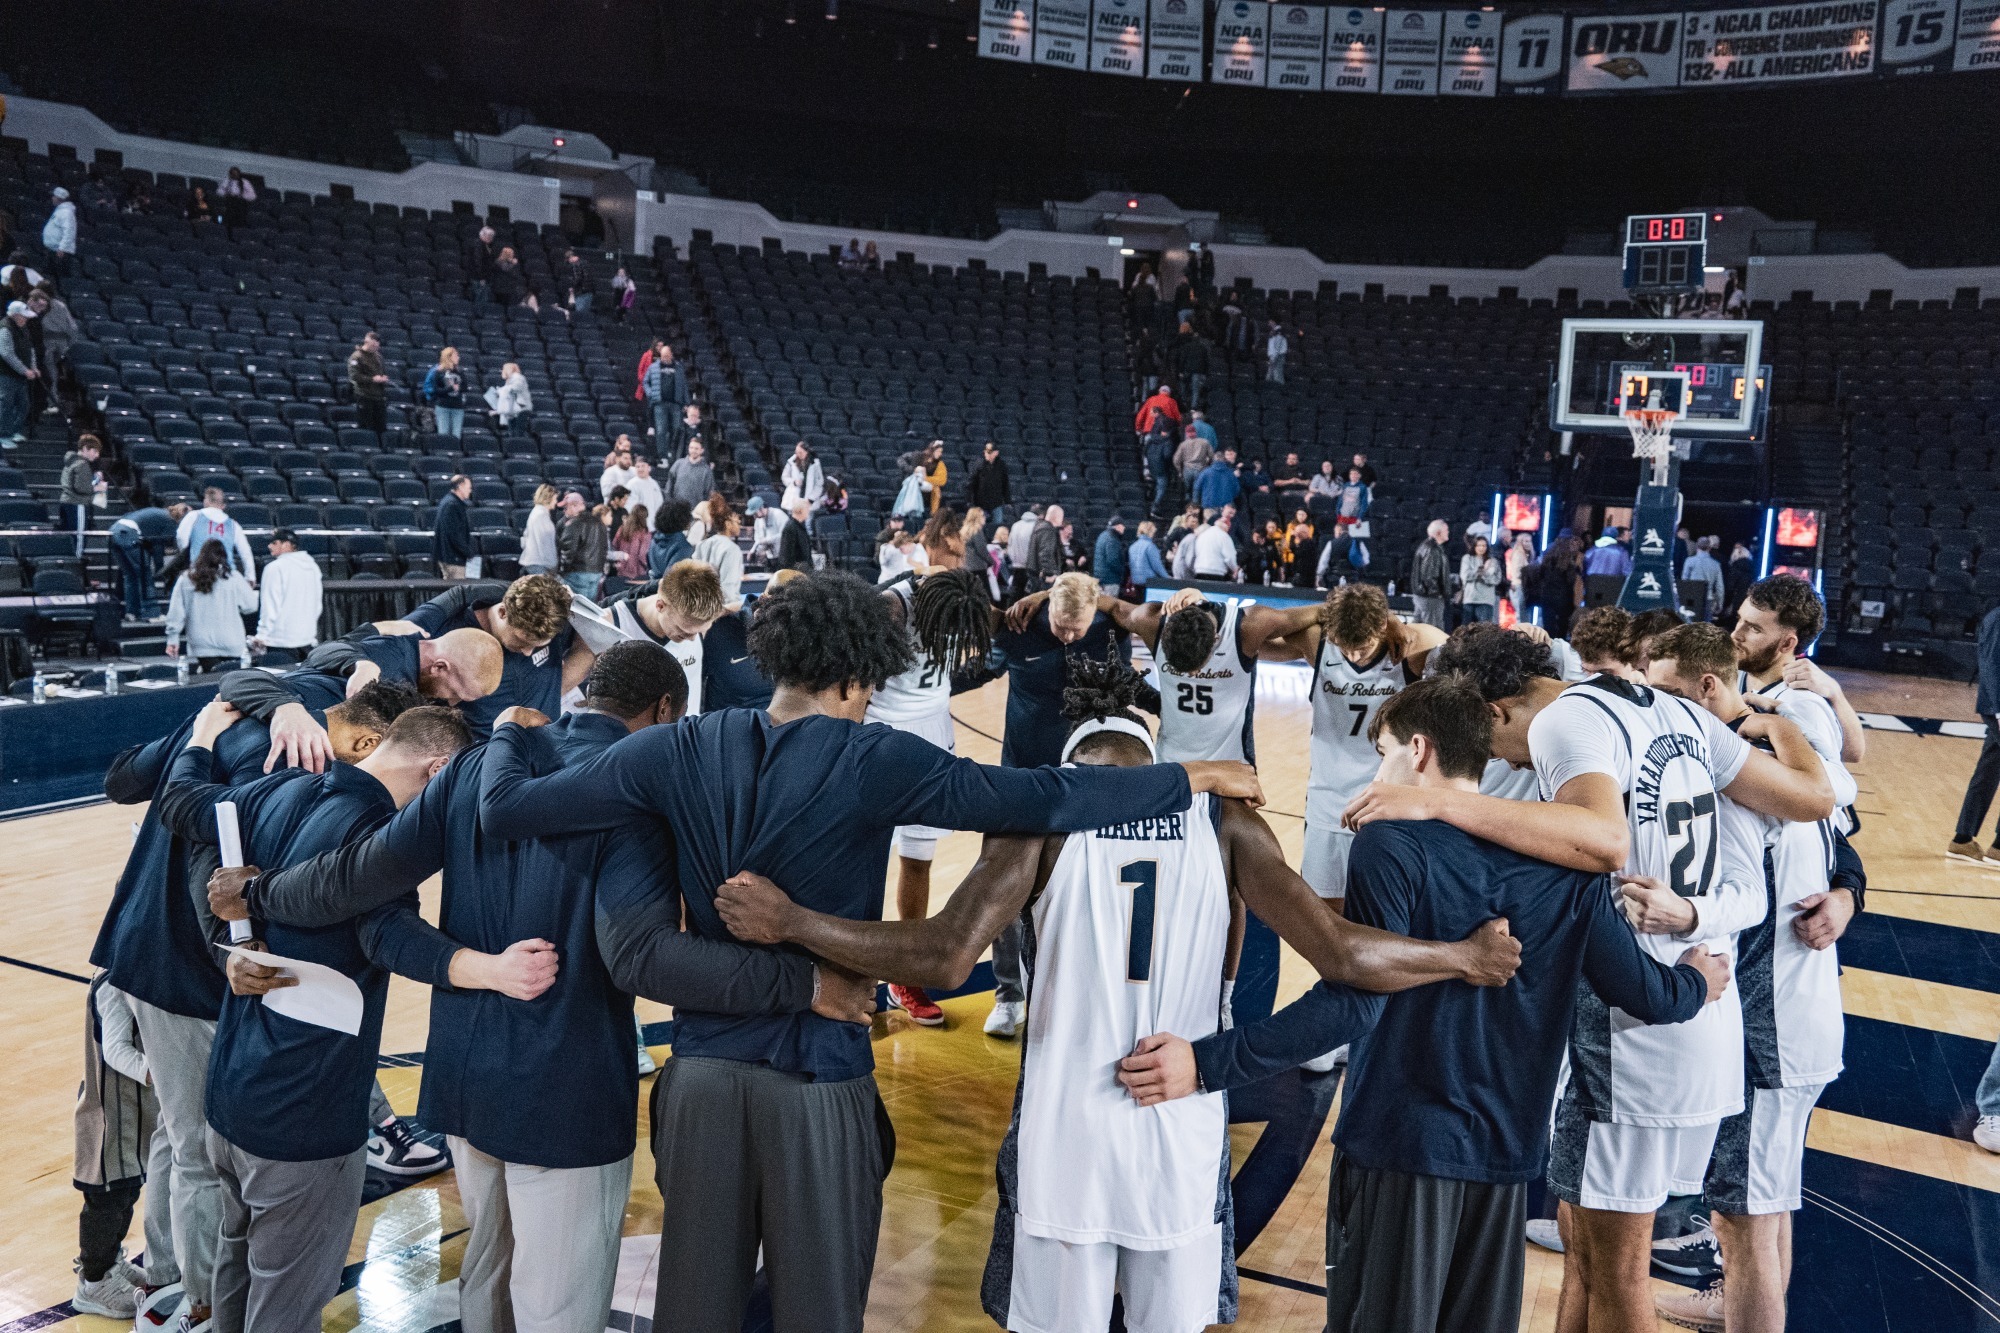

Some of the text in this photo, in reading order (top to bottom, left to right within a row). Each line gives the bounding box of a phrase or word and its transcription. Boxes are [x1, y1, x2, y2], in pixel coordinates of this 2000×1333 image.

[1099, 12, 1140, 29] NCAA
[1688, 16, 1699, 35] 3
[1714, 12, 1762, 34] NCAA
[1767, 2, 1876, 31] CHAMPIONS
[1220, 24, 1262, 39] NCAA
[1895, 11, 1946, 47] 15
[1333, 32, 1376, 46] NCAA
[1450, 36, 1494, 49] NCAA
[1574, 19, 1678, 58] ORU
[1714, 34, 1780, 57] CONFERENCE
[991, 42, 1020, 57] ORU
[1046, 49, 1076, 64] ORU
[1518, 38, 1550, 68] 11
[1102, 57, 1132, 71] ORU
[1161, 63, 1190, 76] ORU
[1724, 58, 1756, 79] ALL
[1759, 51, 1871, 77] AMERICANS
[1225, 69, 1253, 81] ORU
[1280, 73, 1310, 86] ORU
[1336, 76, 1366, 88] ORU
[1394, 79, 1425, 91] ORU
[1452, 80, 1483, 91] ORU
[208, 520, 225, 538] 14
[1323, 680, 1349, 696] Oral
[1350, 682, 1396, 697] Roberts
[1177, 682, 1214, 715] 25
[1348, 703, 1369, 737] 7
[1665, 790, 1719, 899] 27
[1117, 857, 1160, 984] 1
